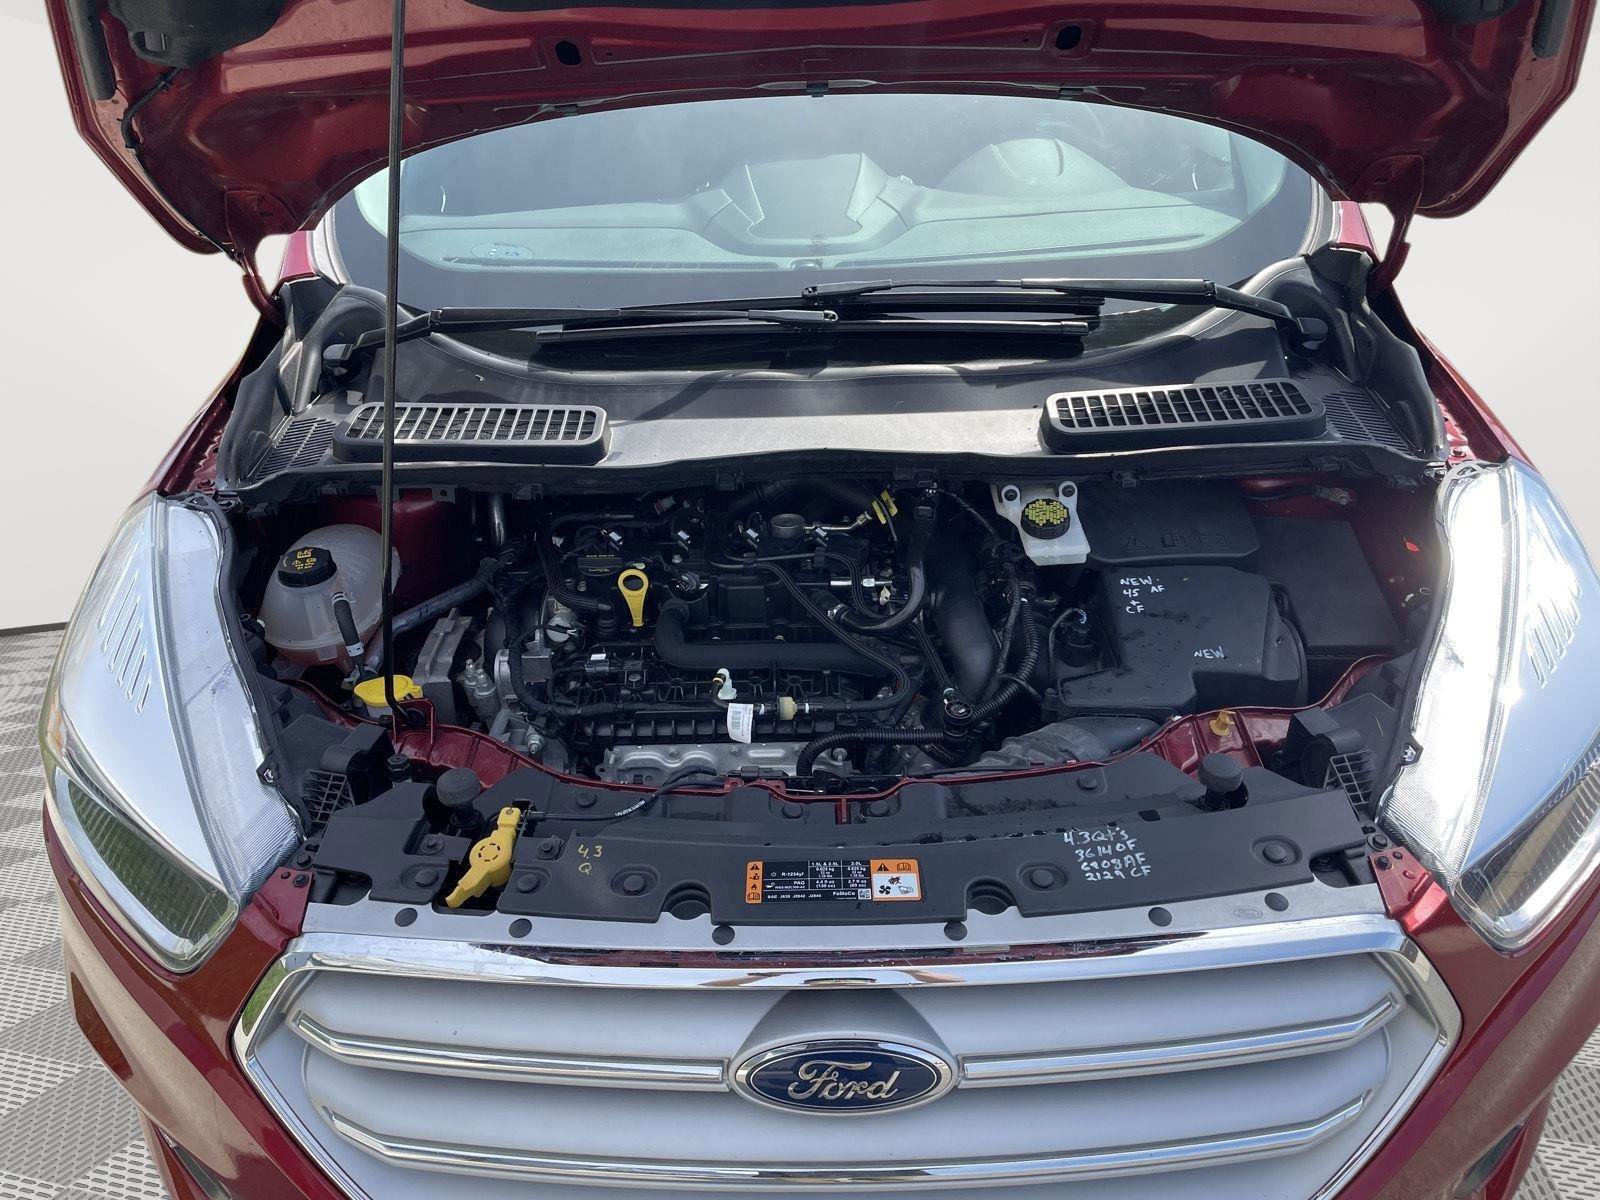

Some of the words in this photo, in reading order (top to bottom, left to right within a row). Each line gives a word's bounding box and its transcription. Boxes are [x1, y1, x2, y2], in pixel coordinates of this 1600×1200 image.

[1120, 576, 1152, 585] NEW
[1123, 588, 1140, 597] 45
[1151, 585, 1165, 593] AF
[1126, 605, 1144, 613] CF
[1194, 646, 1225, 658] NEW
[1115, 838, 1137, 851] OF
[578, 862, 592, 875] Q
[1131, 865, 1152, 877] CF
[787, 1059, 901, 1100] Ford
